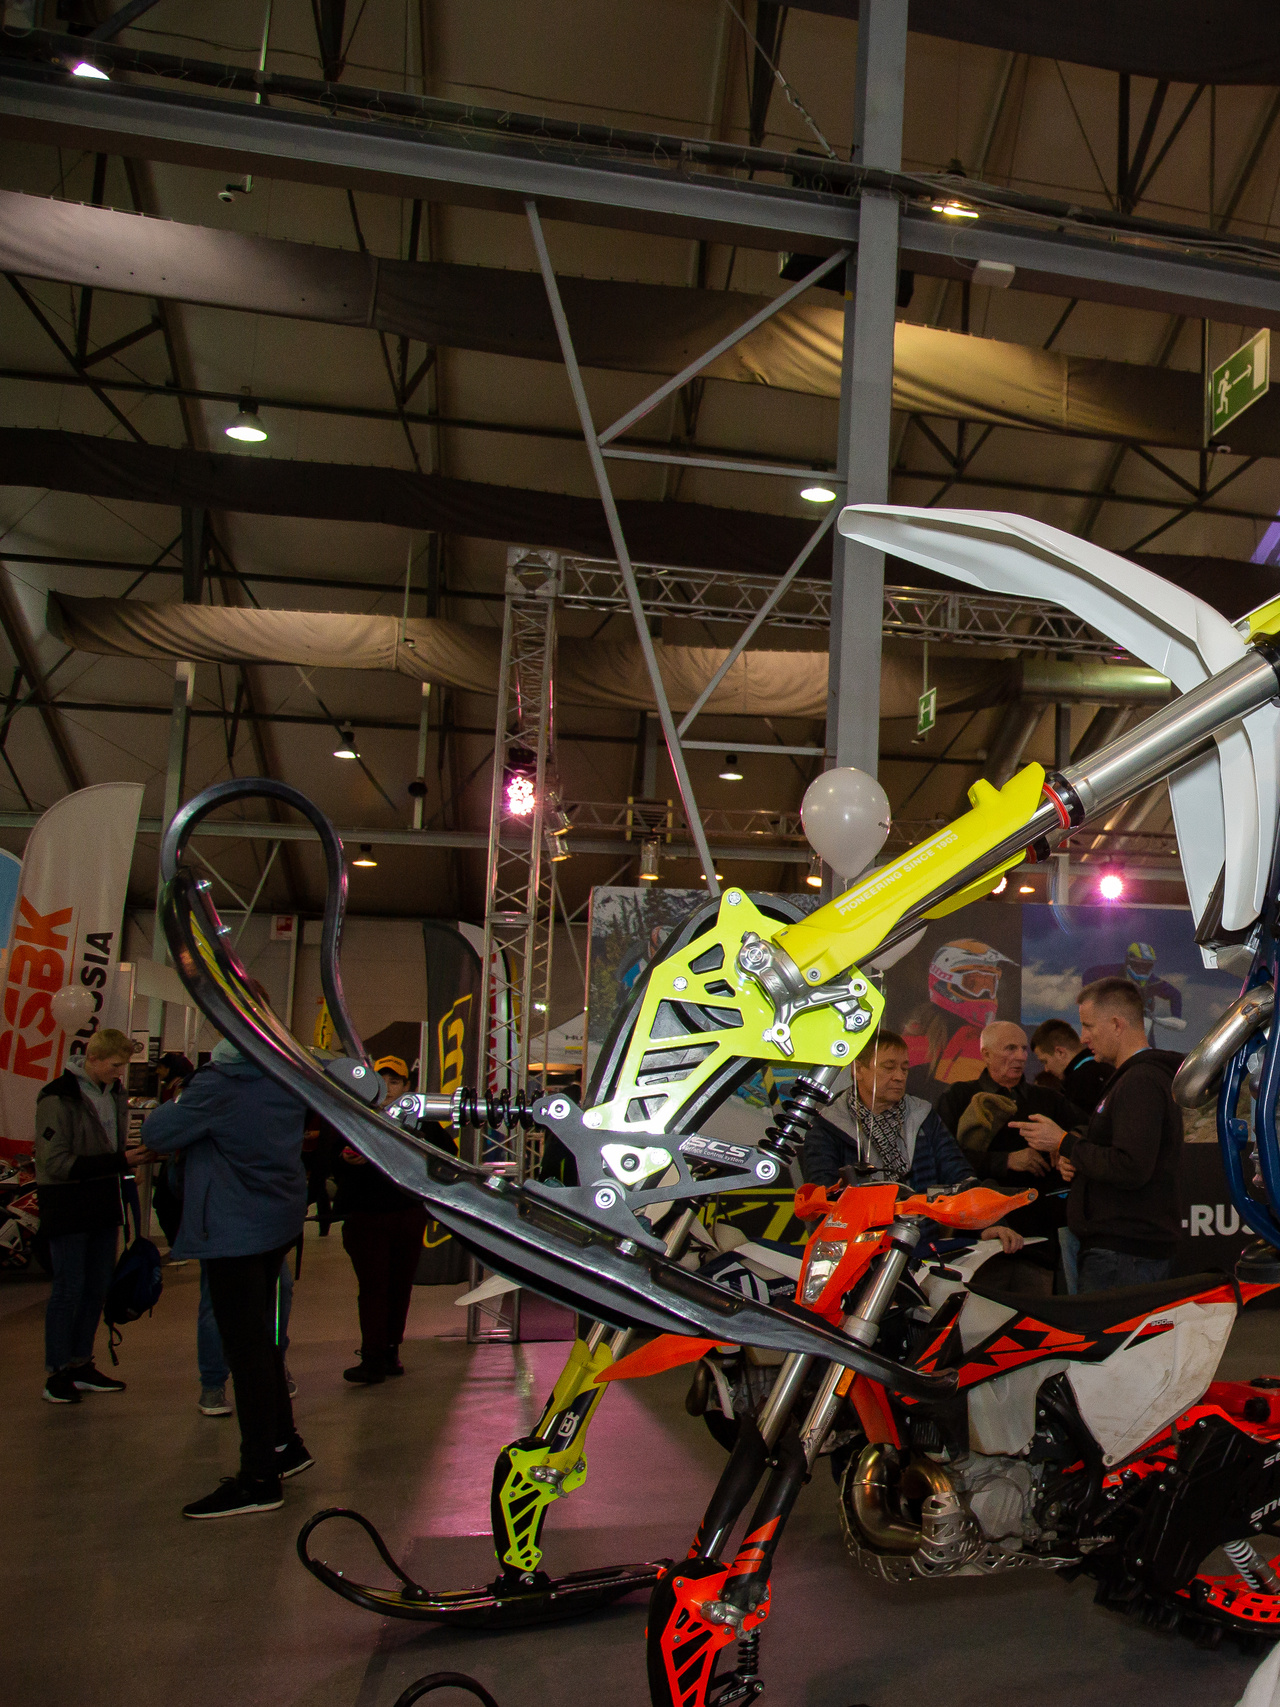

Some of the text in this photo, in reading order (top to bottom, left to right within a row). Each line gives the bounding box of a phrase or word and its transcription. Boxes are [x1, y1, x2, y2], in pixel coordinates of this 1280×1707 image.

[838, 833, 959, 916] PIONEERING SINCE 1903
[687, 1136, 749, 1158] SCS
[719, 1685, 748, 1703] SCS
